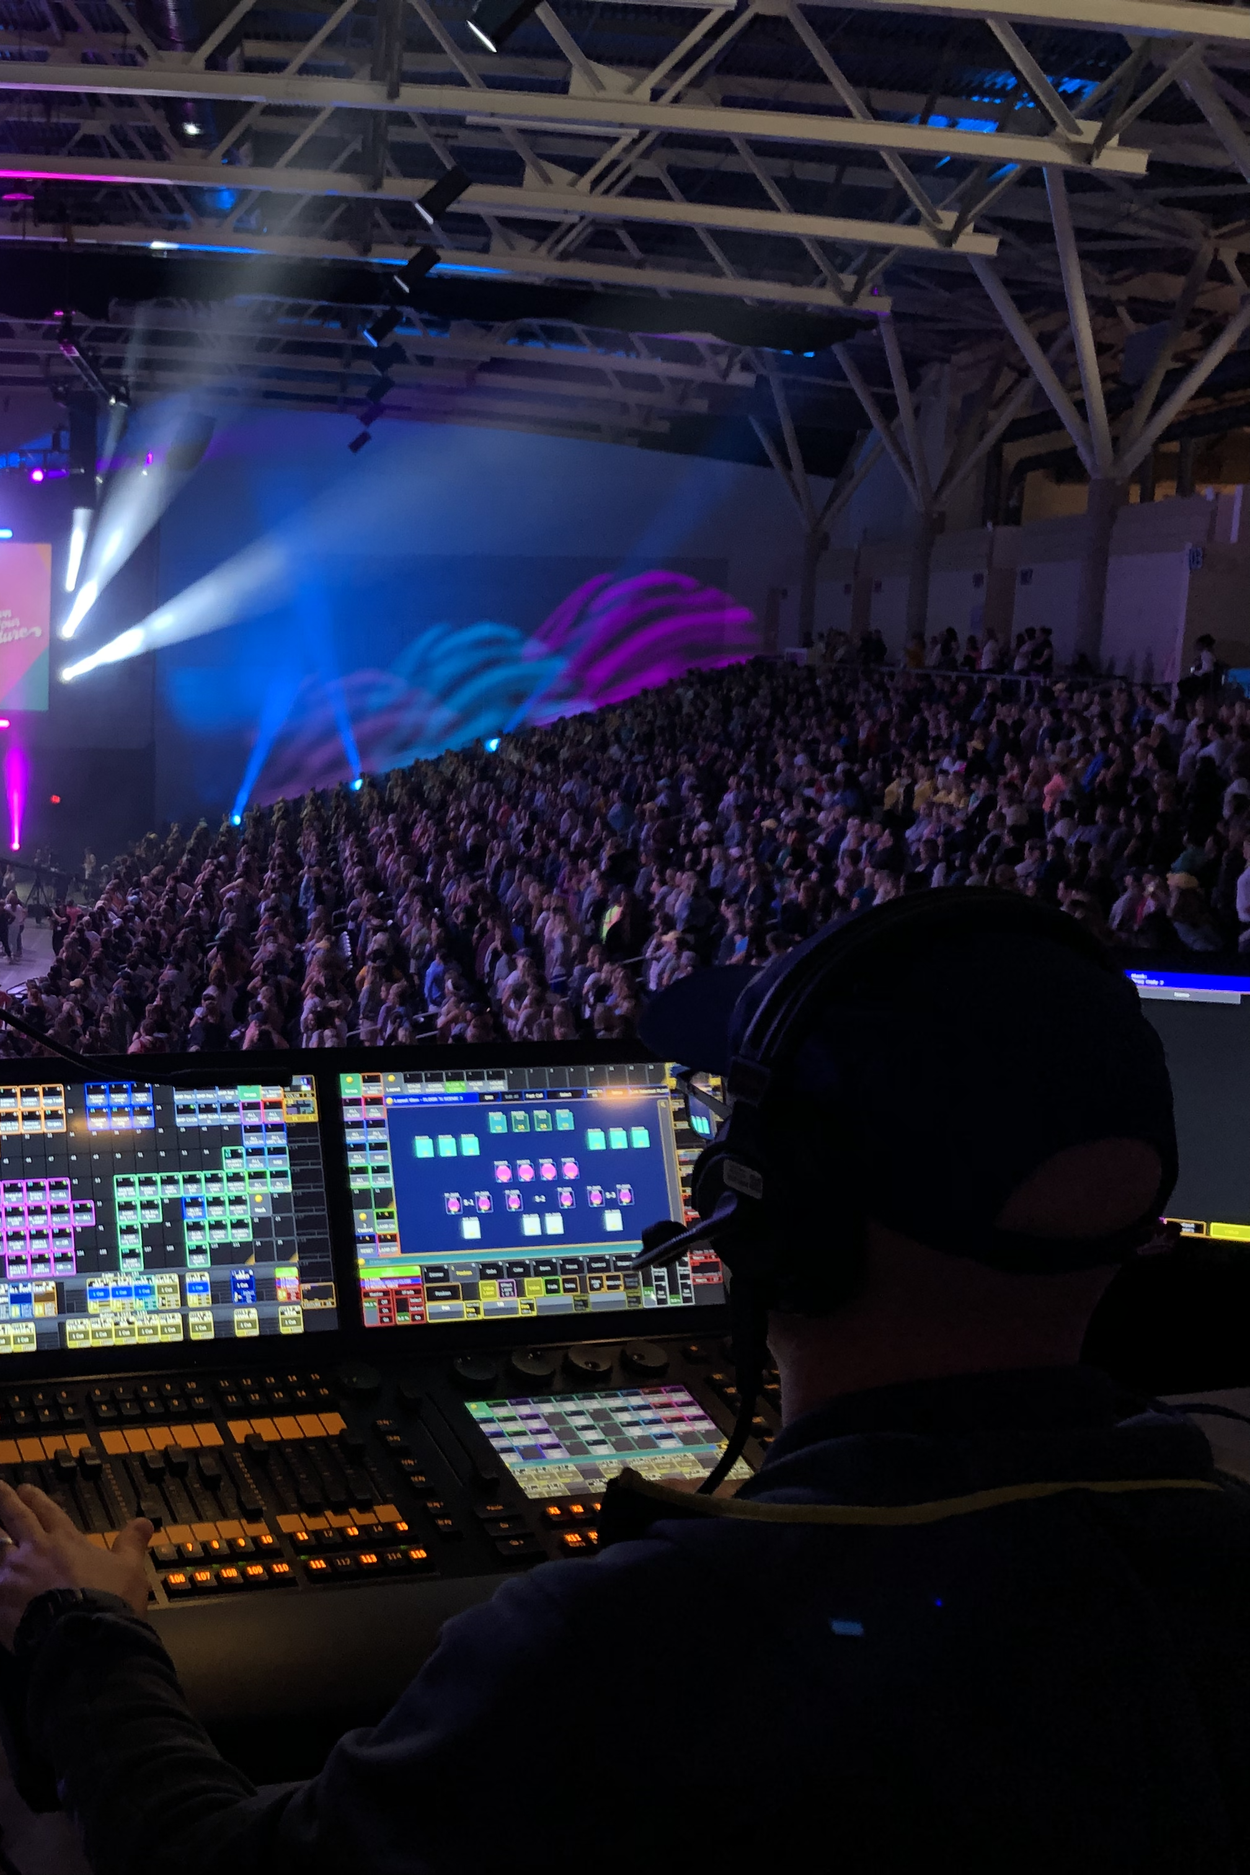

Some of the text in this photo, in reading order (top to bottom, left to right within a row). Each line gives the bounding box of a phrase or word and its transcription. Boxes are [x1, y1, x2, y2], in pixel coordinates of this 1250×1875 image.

[261, 1535, 273, 1544] 10
[387, 1552, 402, 1560] 114
[272, 1563, 289, 1573] 110
[309, 1559, 327, 1569] 111
[221, 1568, 238, 1578] 108
[247, 1565, 263, 1575] 109
[195, 1571, 210, 1581] 107
